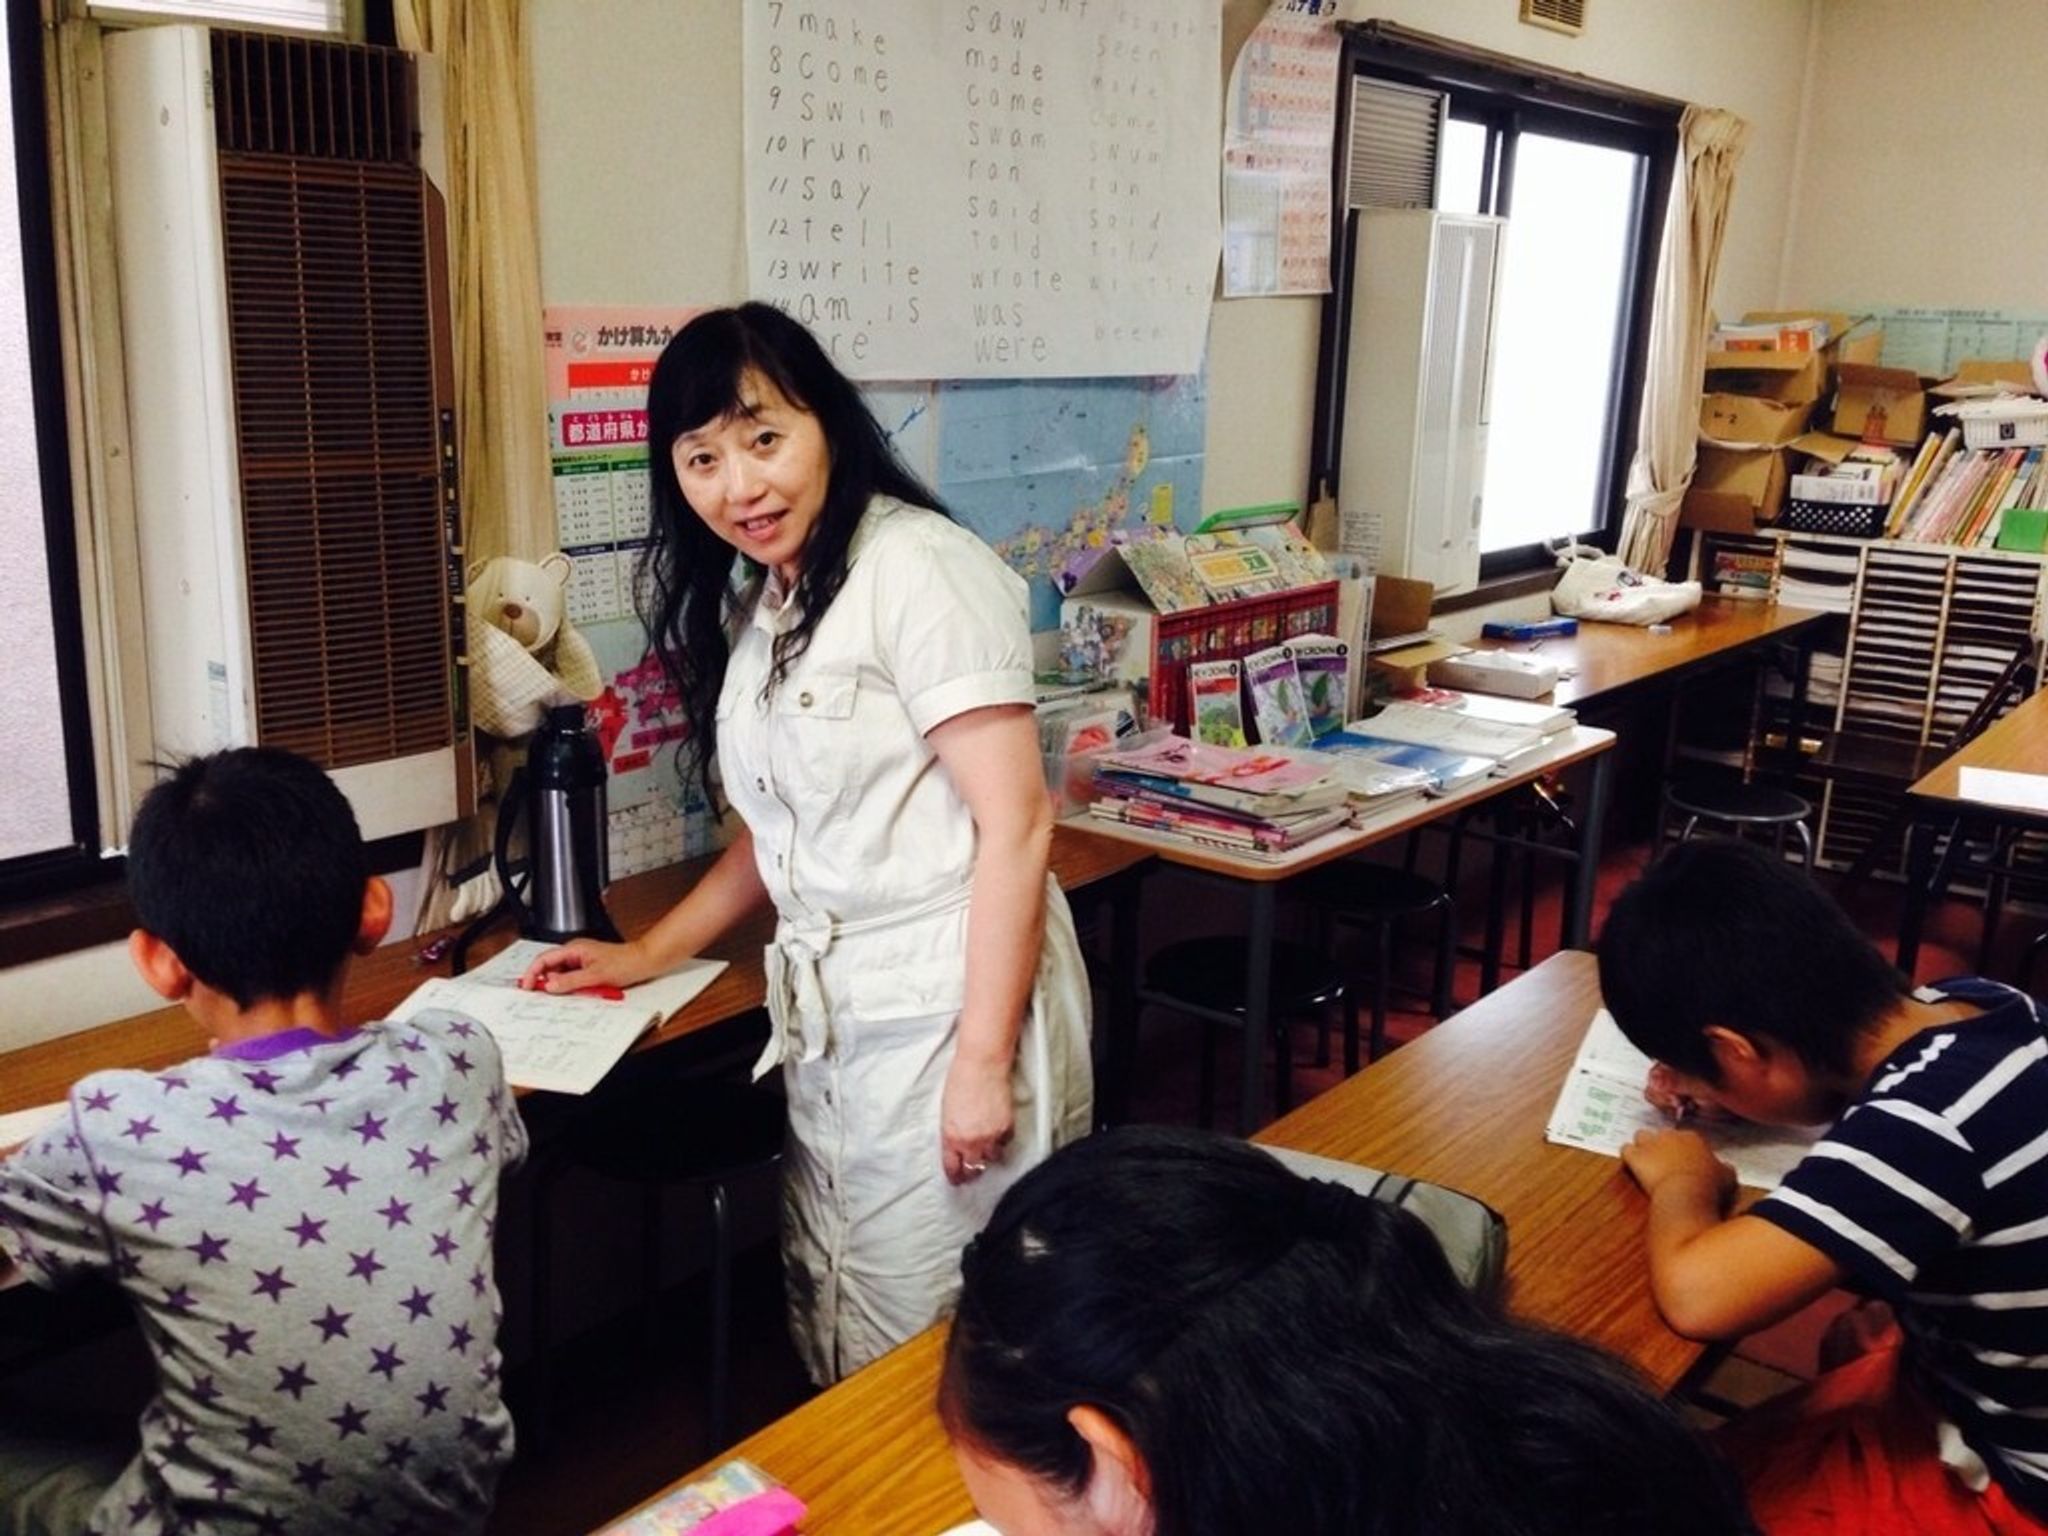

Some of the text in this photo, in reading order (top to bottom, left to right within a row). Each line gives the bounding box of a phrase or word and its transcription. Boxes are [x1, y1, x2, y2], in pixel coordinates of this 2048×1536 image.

[966, 5, 1027, 39] saw
[768, 2, 783, 28] 7
[800, 13, 885, 55] make
[965, 48, 1043, 81] made
[770, 45, 782, 74] 8
[770, 86, 781, 110] 9
[766, 135, 787, 154] 10
[802, 136, 871, 163] run
[968, 160, 1020, 182] ran
[768, 177, 787, 195] 11
[802, 176, 870, 210] say
[968, 195, 1041, 225] said
[768, 218, 788, 236] 12
[803, 217, 891, 248] tell
[971, 230, 1041, 260] told
[768, 260, 788, 279] 13
[800, 260, 920, 285] write
[971, 269, 1062, 292] wrote
[973, 303, 1024, 327] was
[831, 334, 868, 360] re
[974, 336, 1047, 362] were
